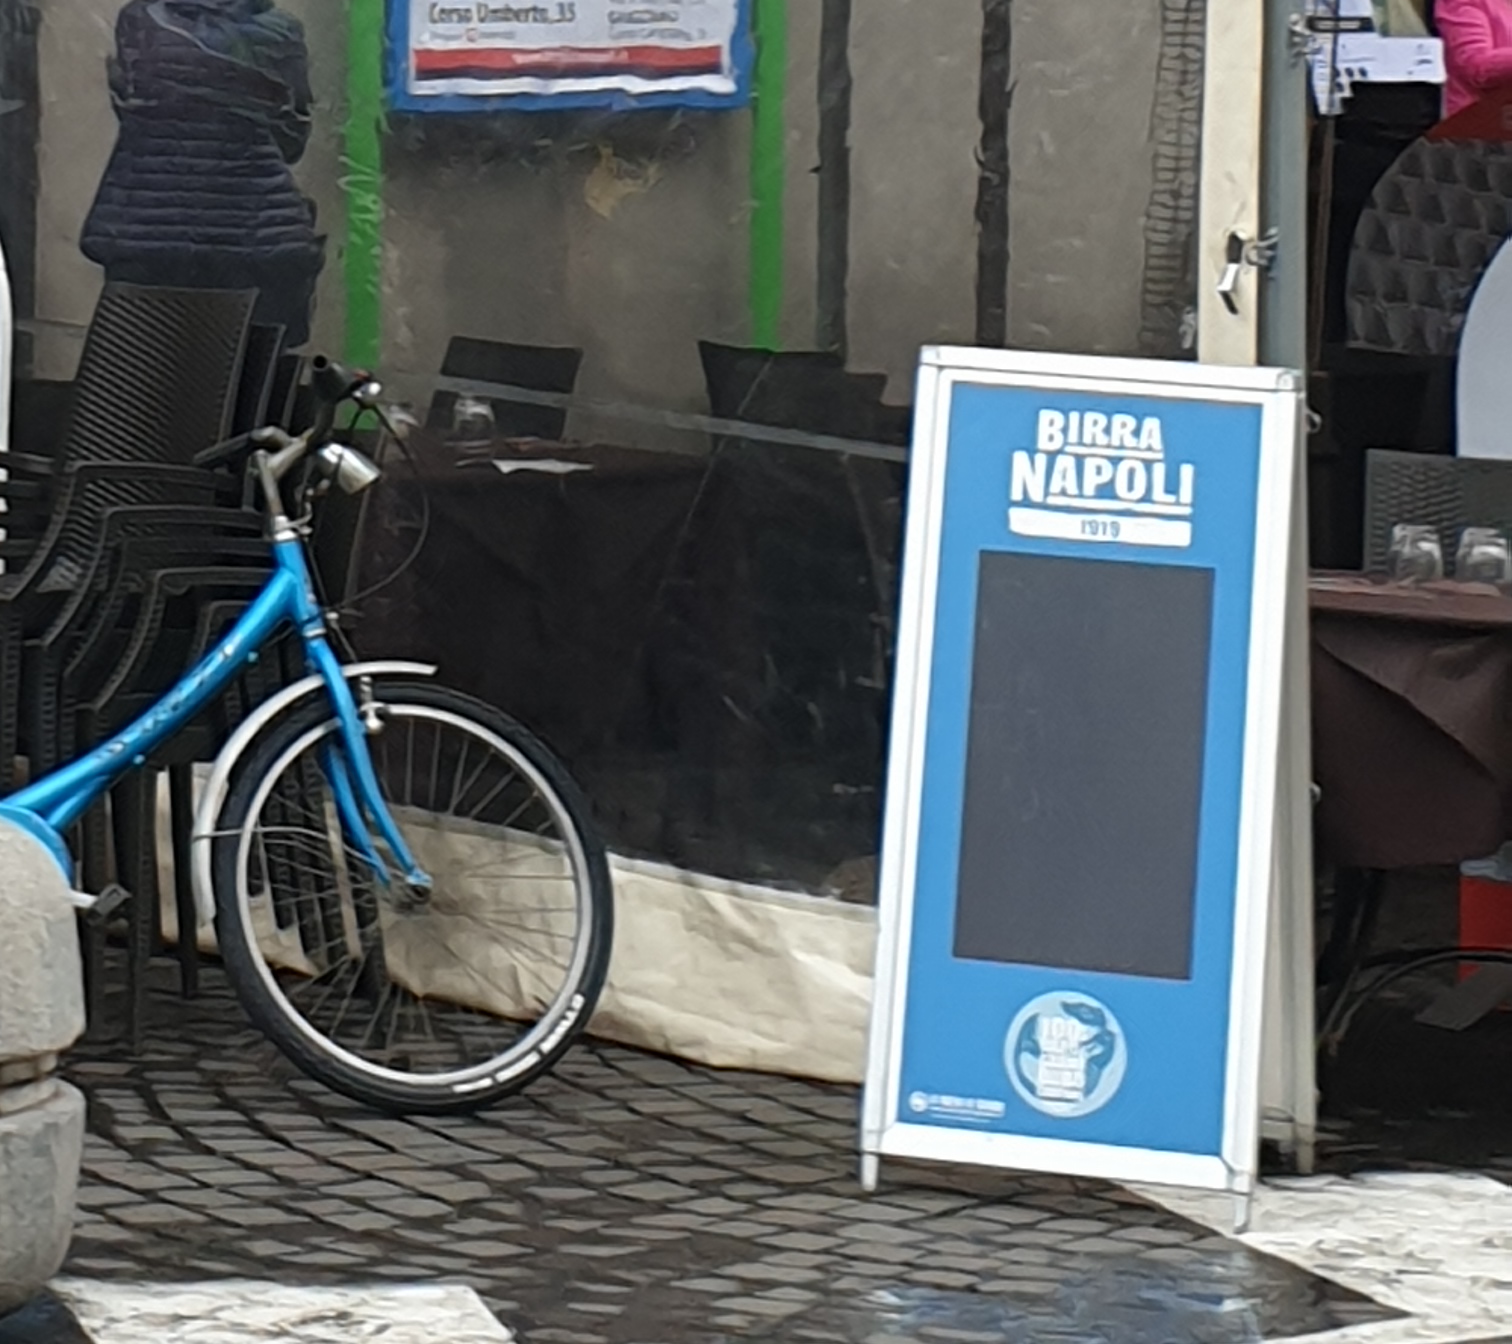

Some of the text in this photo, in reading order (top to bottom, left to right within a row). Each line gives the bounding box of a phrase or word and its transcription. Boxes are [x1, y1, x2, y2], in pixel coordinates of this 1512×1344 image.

[429, 2, 473, 24] Corso
[1037, 408, 1164, 452] BIRRA
[1010, 450, 1195, 505] NAPOLI
